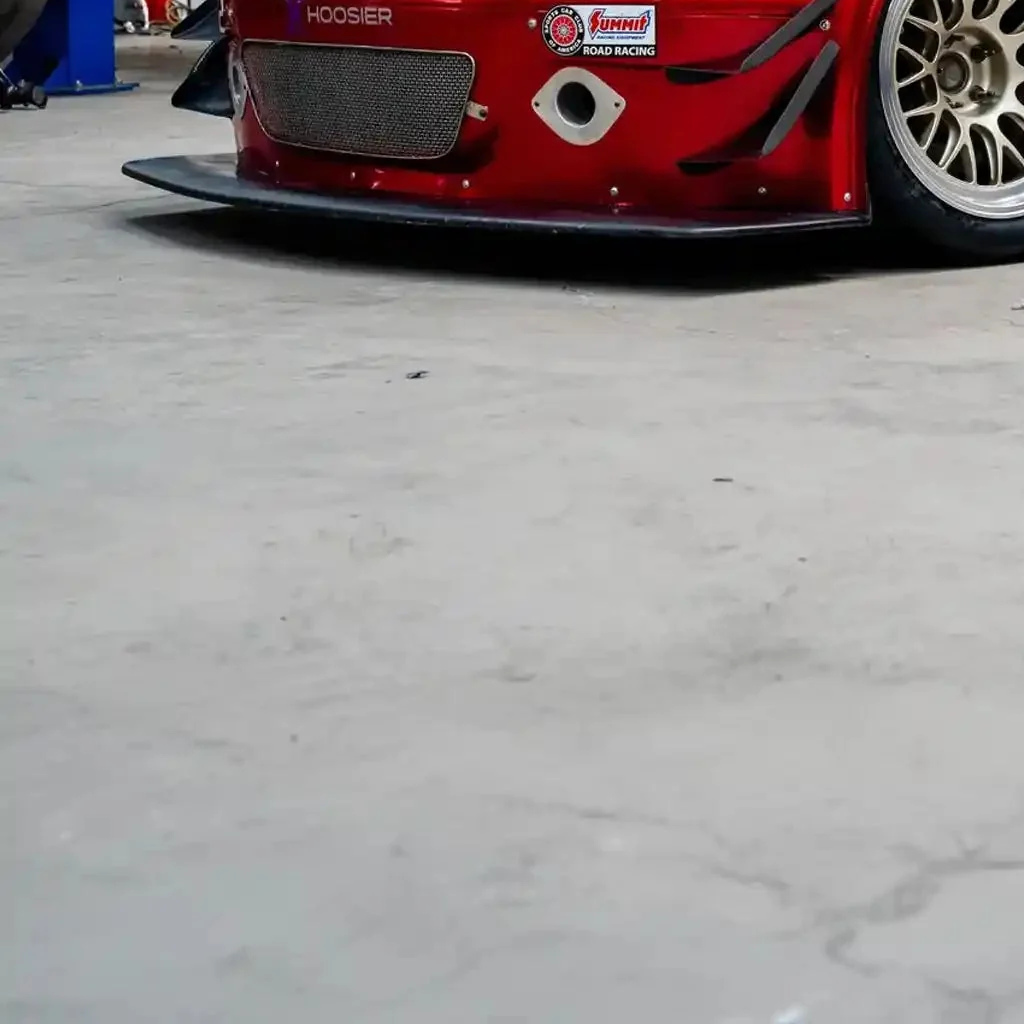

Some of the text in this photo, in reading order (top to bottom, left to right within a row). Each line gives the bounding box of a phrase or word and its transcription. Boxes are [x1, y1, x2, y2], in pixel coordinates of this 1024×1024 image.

[306, 4, 393, 26] HOOSIER
[583, 46, 655, 56] ROAD RACING
